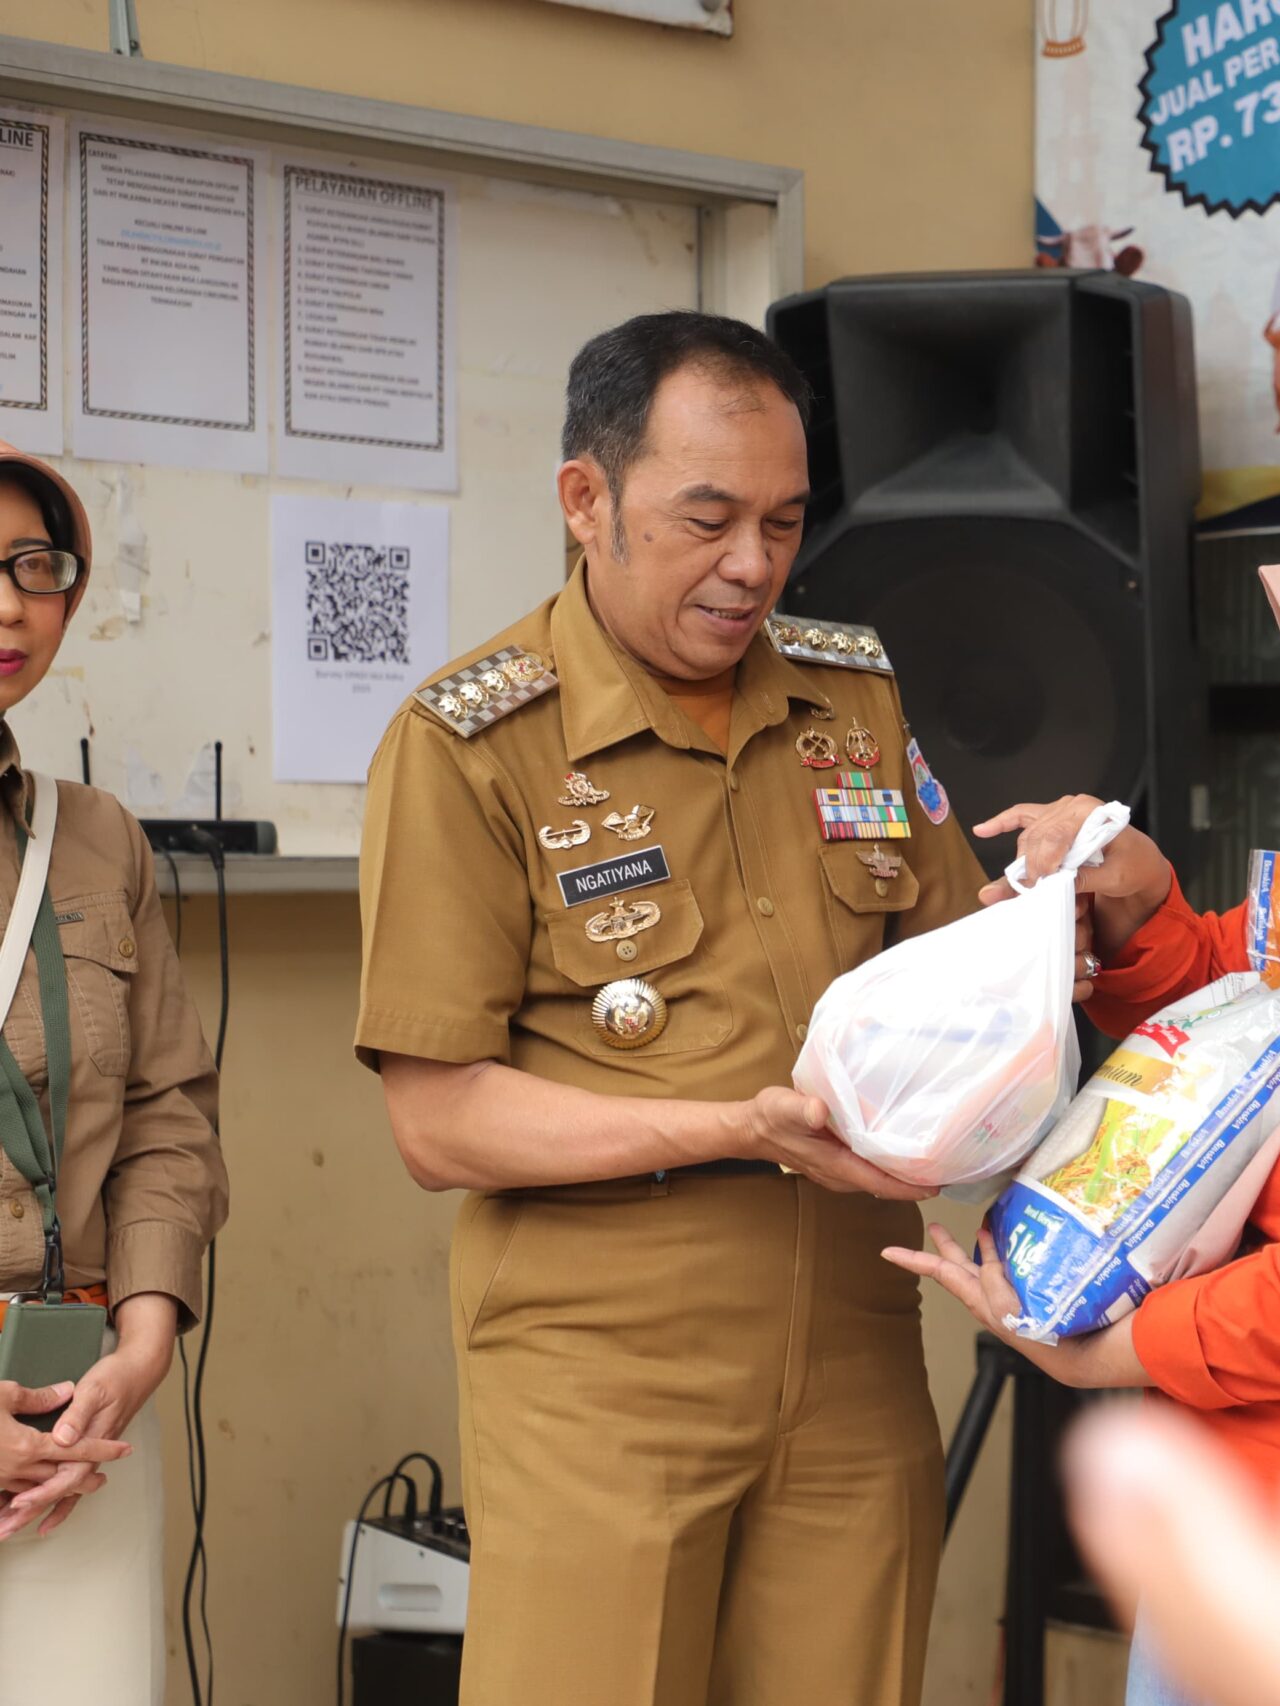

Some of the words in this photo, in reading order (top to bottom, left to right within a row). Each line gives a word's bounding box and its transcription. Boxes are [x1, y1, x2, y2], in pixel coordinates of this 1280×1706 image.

[1150, 70, 1223, 126] JUAL
[0, 128, 33, 147] LINE
[1166, 115, 1233, 173] RP.
[295, 176, 376, 200] PELAYANAN
[575, 859, 653, 893] NGATIYANA
